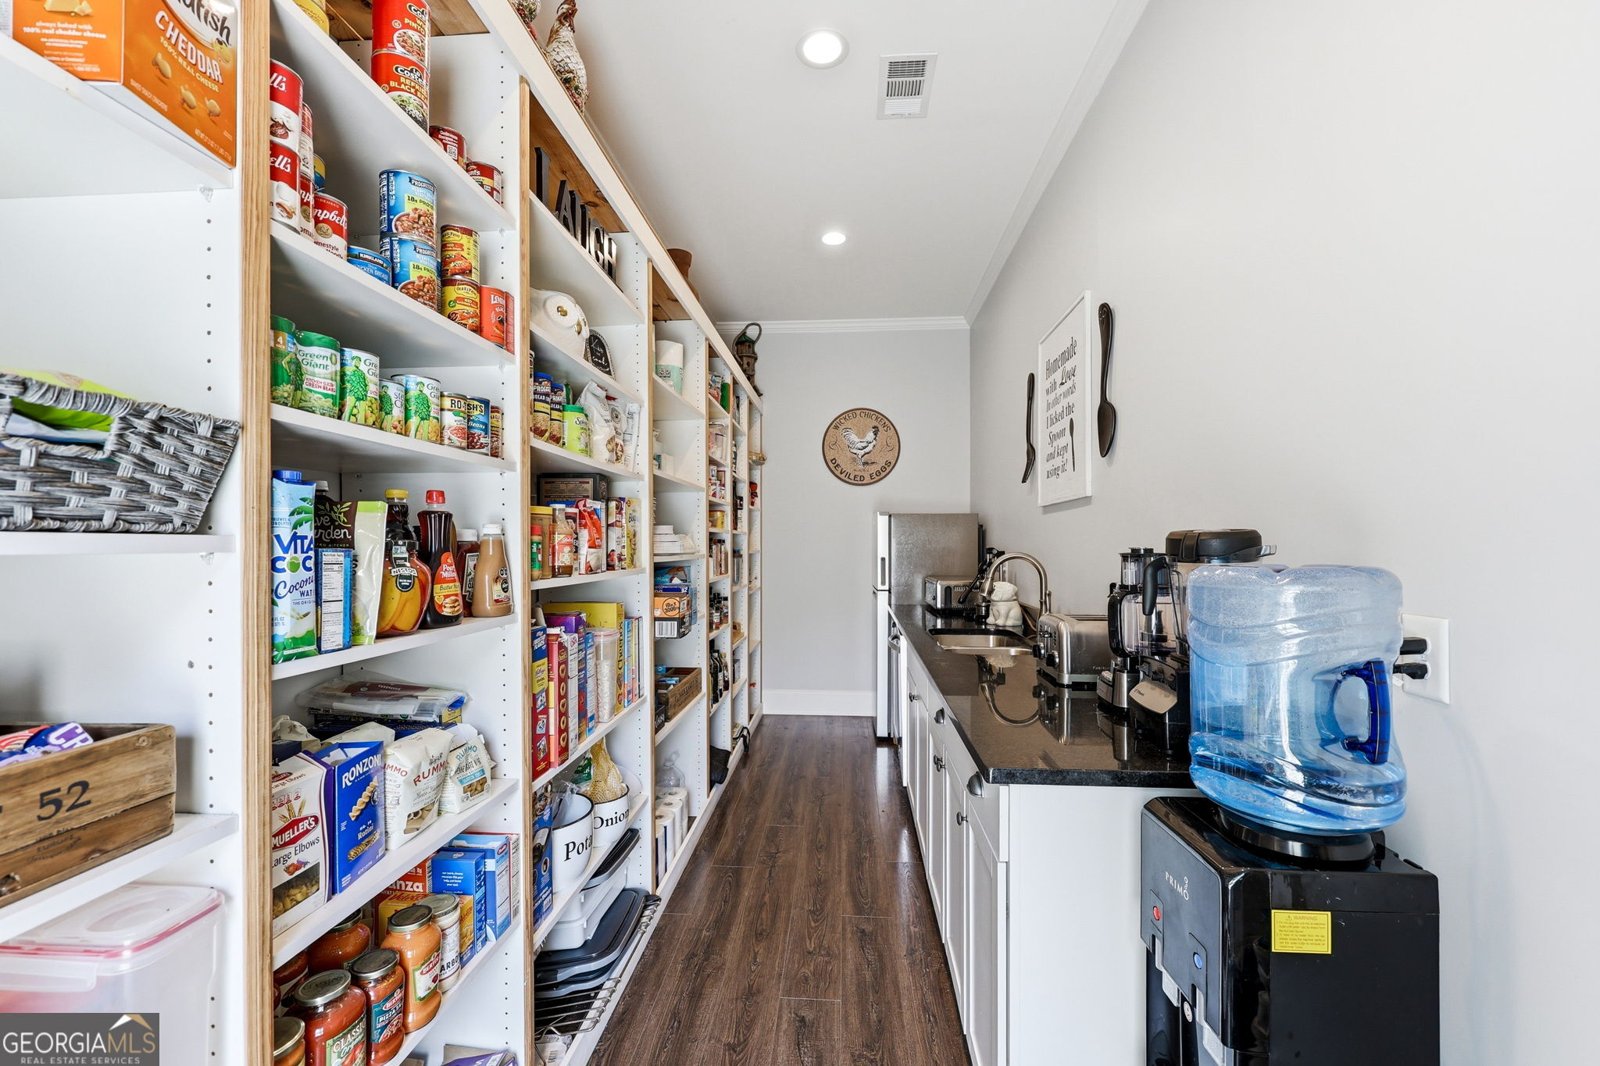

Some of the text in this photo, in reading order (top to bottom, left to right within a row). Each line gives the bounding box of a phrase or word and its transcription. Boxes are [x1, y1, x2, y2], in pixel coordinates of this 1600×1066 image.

[155, 10, 223, 84] CHEDDAR
[177, 57, 195, 77] REAL
[195, 72, 220, 93] CHEESE
[389, 80, 416, 95] BLACK
[277, 335, 284, 345] 4
[297, 349, 329, 362] Green
[301, 357, 330, 372] Giant
[1045, 336, 1077, 381] Homemade
[1045, 378, 1058, 397] with
[832, 410, 891, 433] WICKED CHICKENS
[1065, 401, 1075, 419] the
[1048, 427, 1067, 448] Spoon
[1046, 442, 1069, 462] and kept
[830, 457, 892, 482] DEVILED EGGS
[273, 531, 314, 555] VITA
[342, 753, 383, 789] RONZONI
[37, 780, 92, 821] 52
[271, 815, 318, 847] MUELLER'S
[294, 835, 321, 857] Elbows
[1164, 871, 1190, 900] PRIMO
